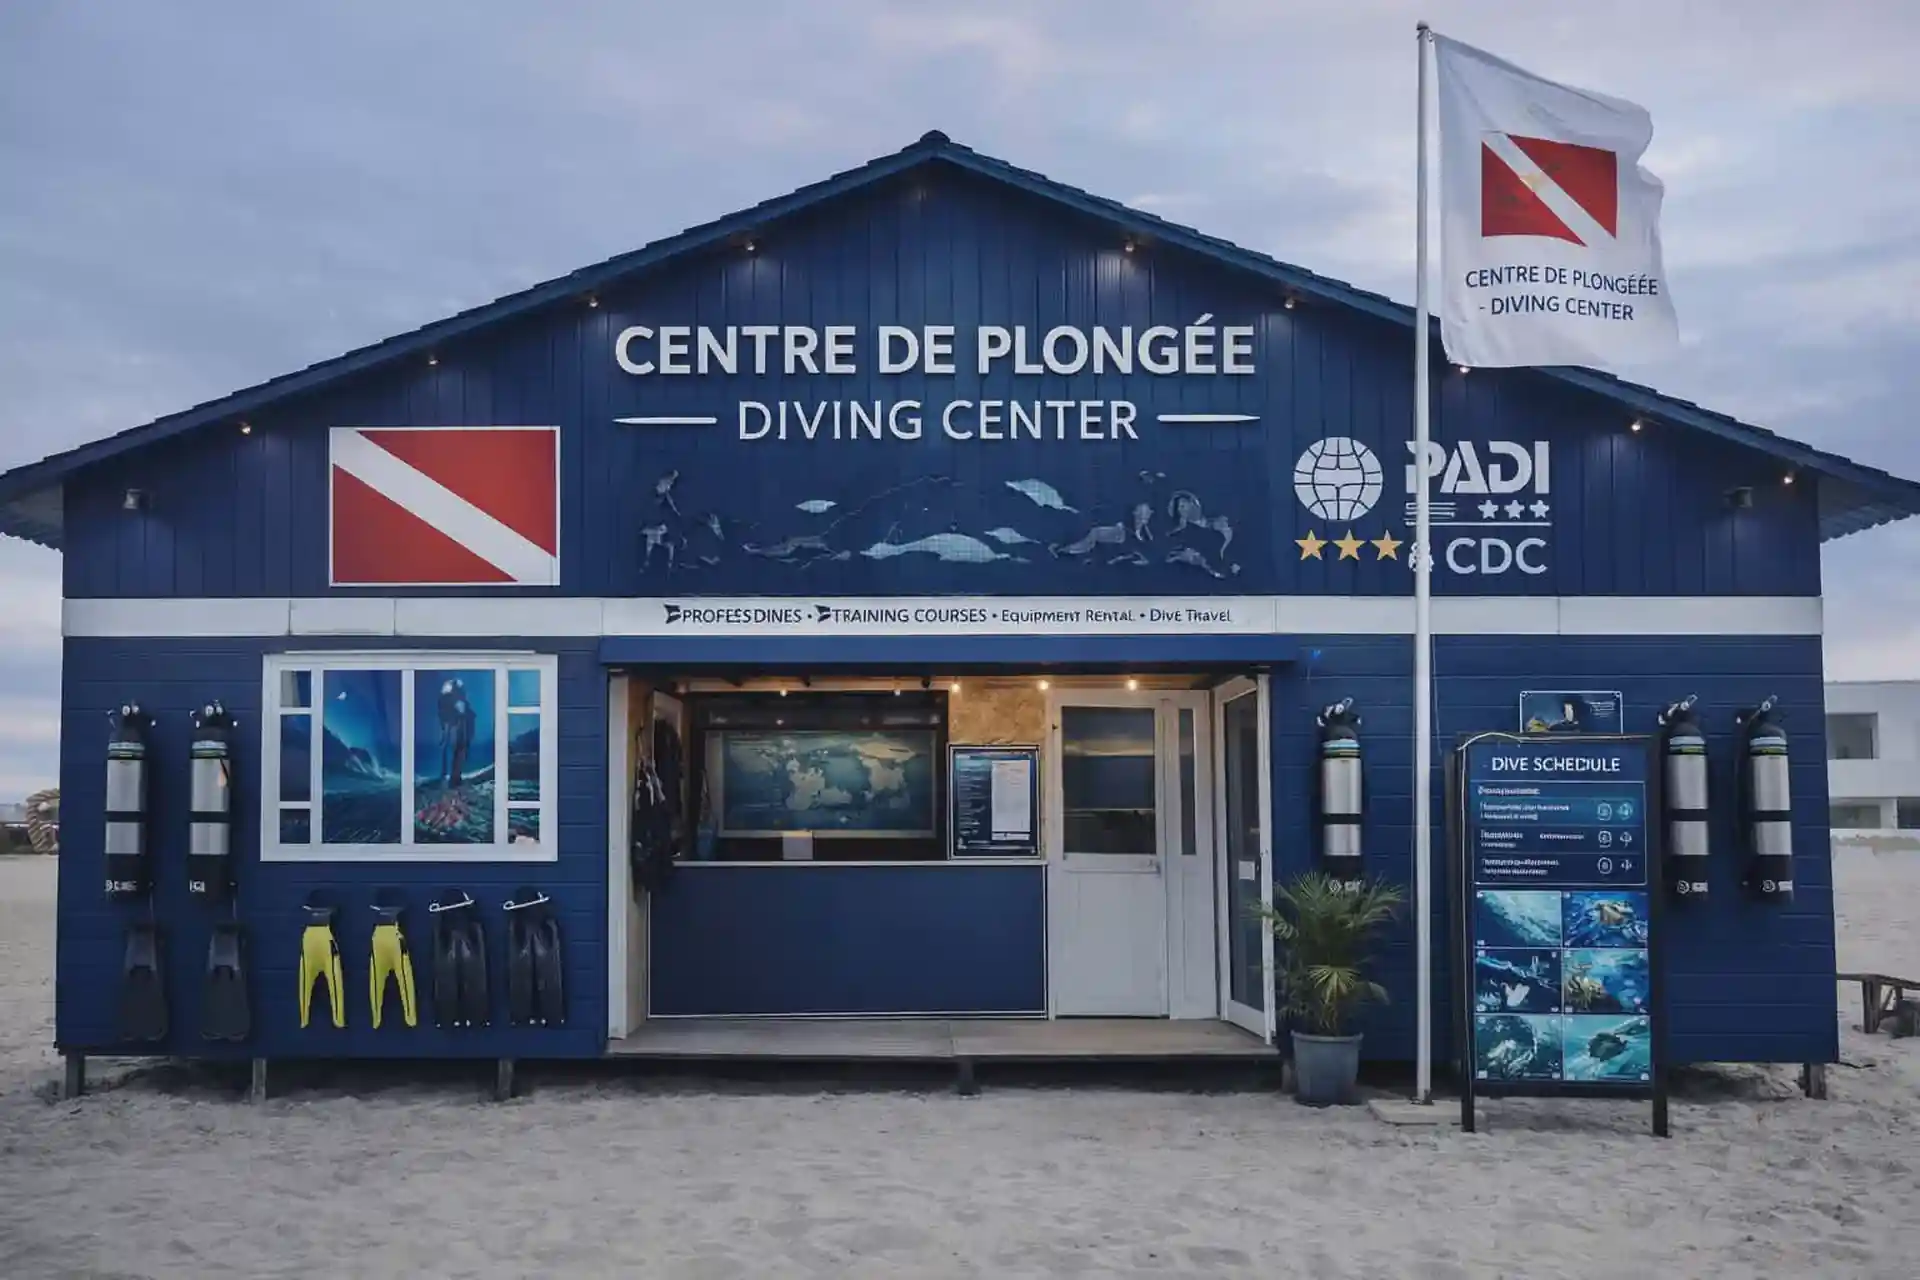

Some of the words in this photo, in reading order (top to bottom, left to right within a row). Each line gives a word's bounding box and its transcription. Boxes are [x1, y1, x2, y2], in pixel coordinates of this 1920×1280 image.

[1466, 266, 1540, 288] CENTRE
[1544, 266, 1567, 285] DE
[1491, 295, 1560, 315] DIVING
[1565, 298, 1634, 321] CENTER
[615, 325, 857, 375] CENTRE
[878, 325, 956, 375] DE
[978, 313, 1255, 375] PLONGÉE
[739, 399, 922, 441] DIVING
[942, 399, 1139, 441] CENTER
[1405, 440, 1550, 494] PADI
[1446, 537, 1547, 574] CDC
[831, 608, 910, 623] TRAINING
[914, 608, 987, 623] COURSES
[1491, 756, 1529, 772] DIVE
